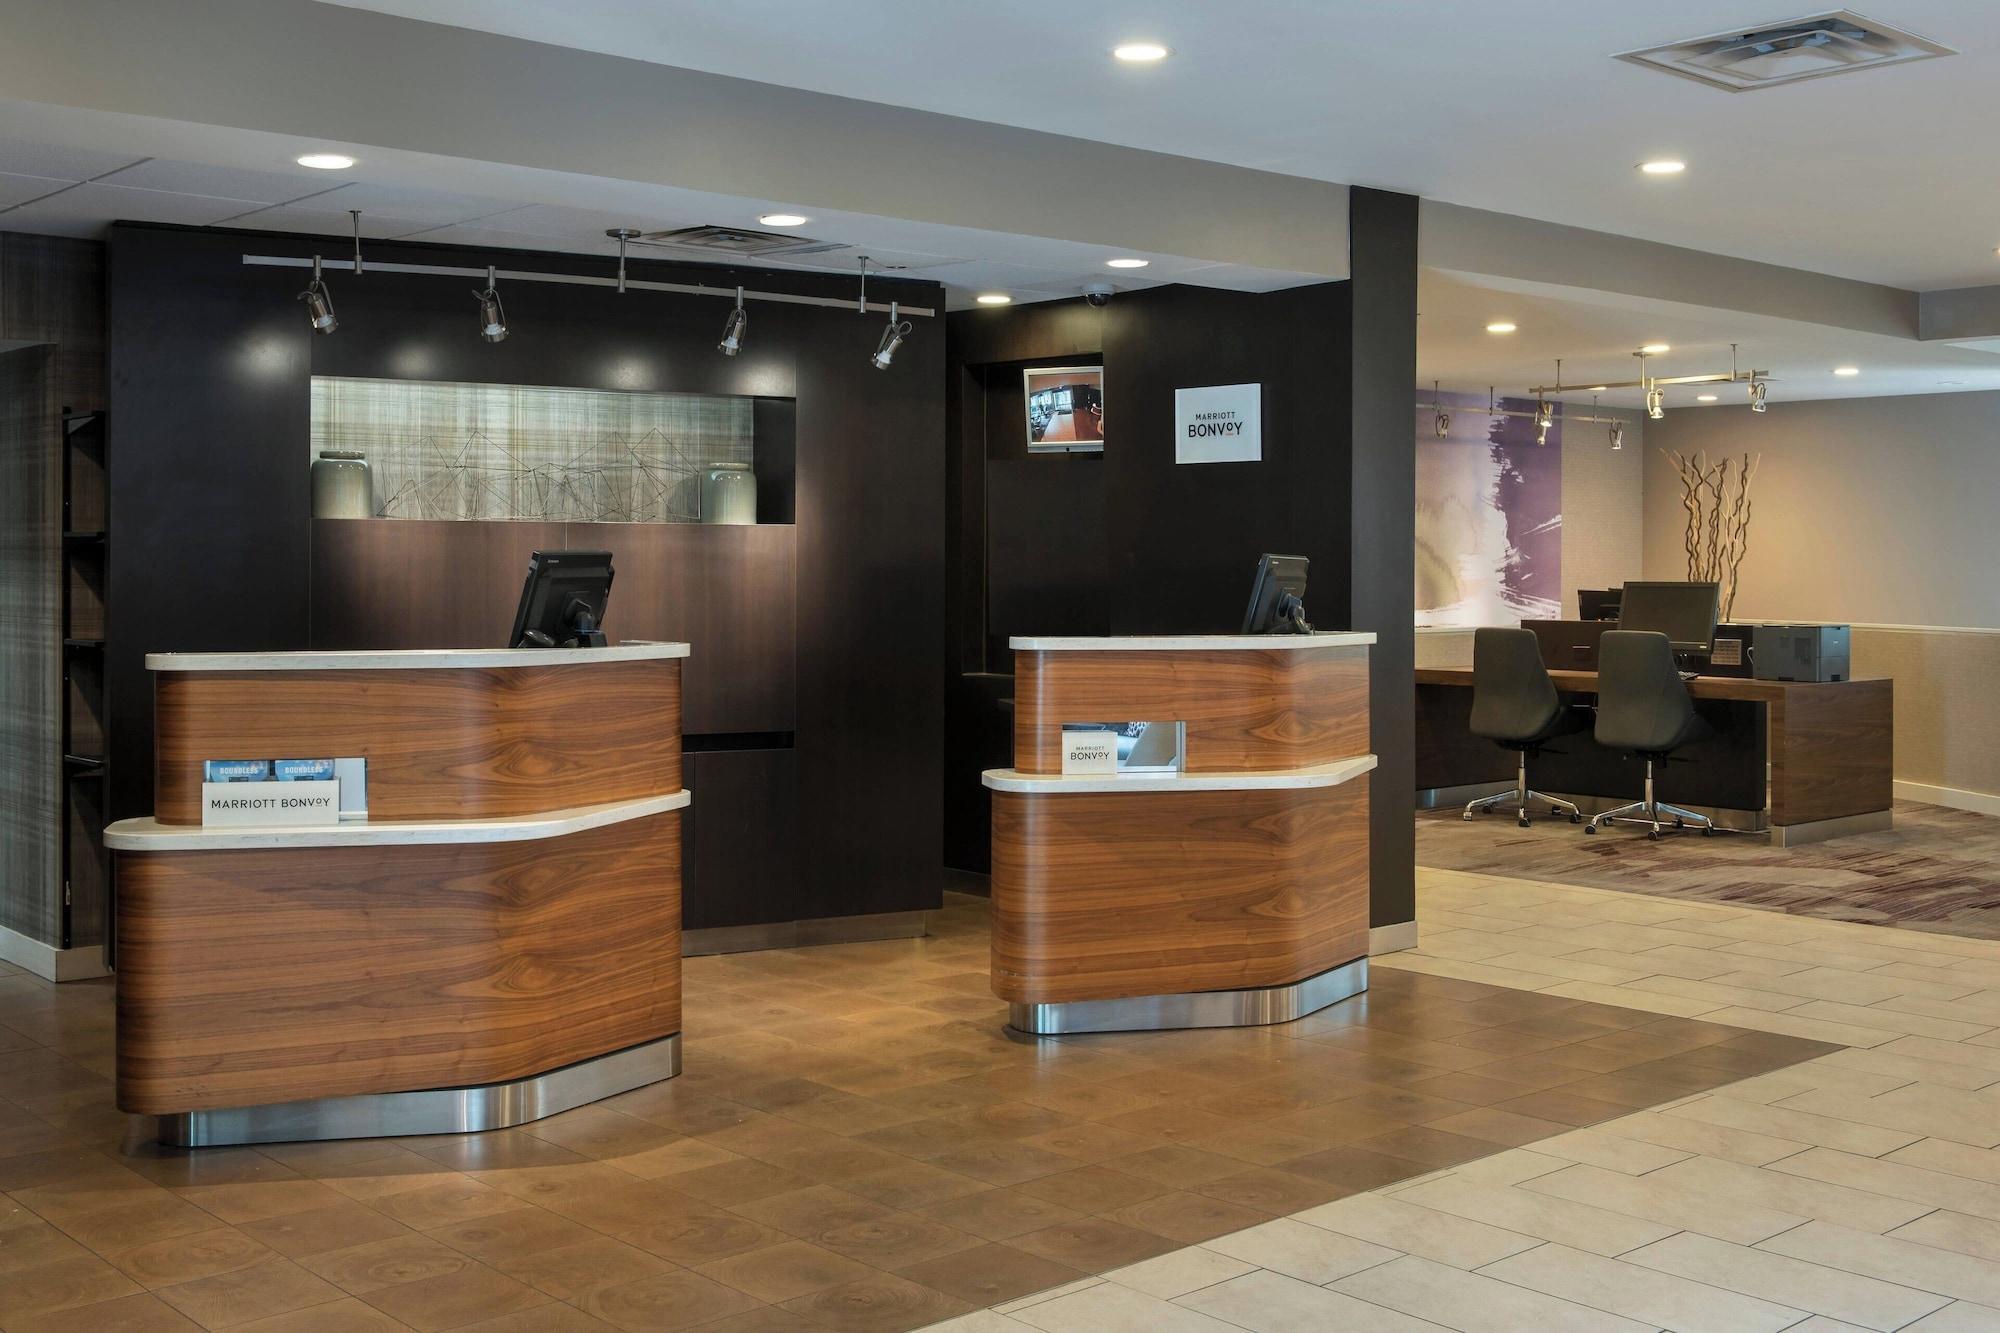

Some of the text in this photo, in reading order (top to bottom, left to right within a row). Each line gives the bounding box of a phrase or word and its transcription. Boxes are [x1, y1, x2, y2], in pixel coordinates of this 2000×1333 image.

[1195, 411, 1236, 421] MARRIOTT
[1188, 421, 1243, 438] BONVOY
[1070, 751, 1110, 760] BONVOY
[219, 766, 258, 774] BOUNDLESS
[284, 766, 324, 774] BOUNDLESS
[211, 797, 331, 809] MARRIOTT BONVOY
